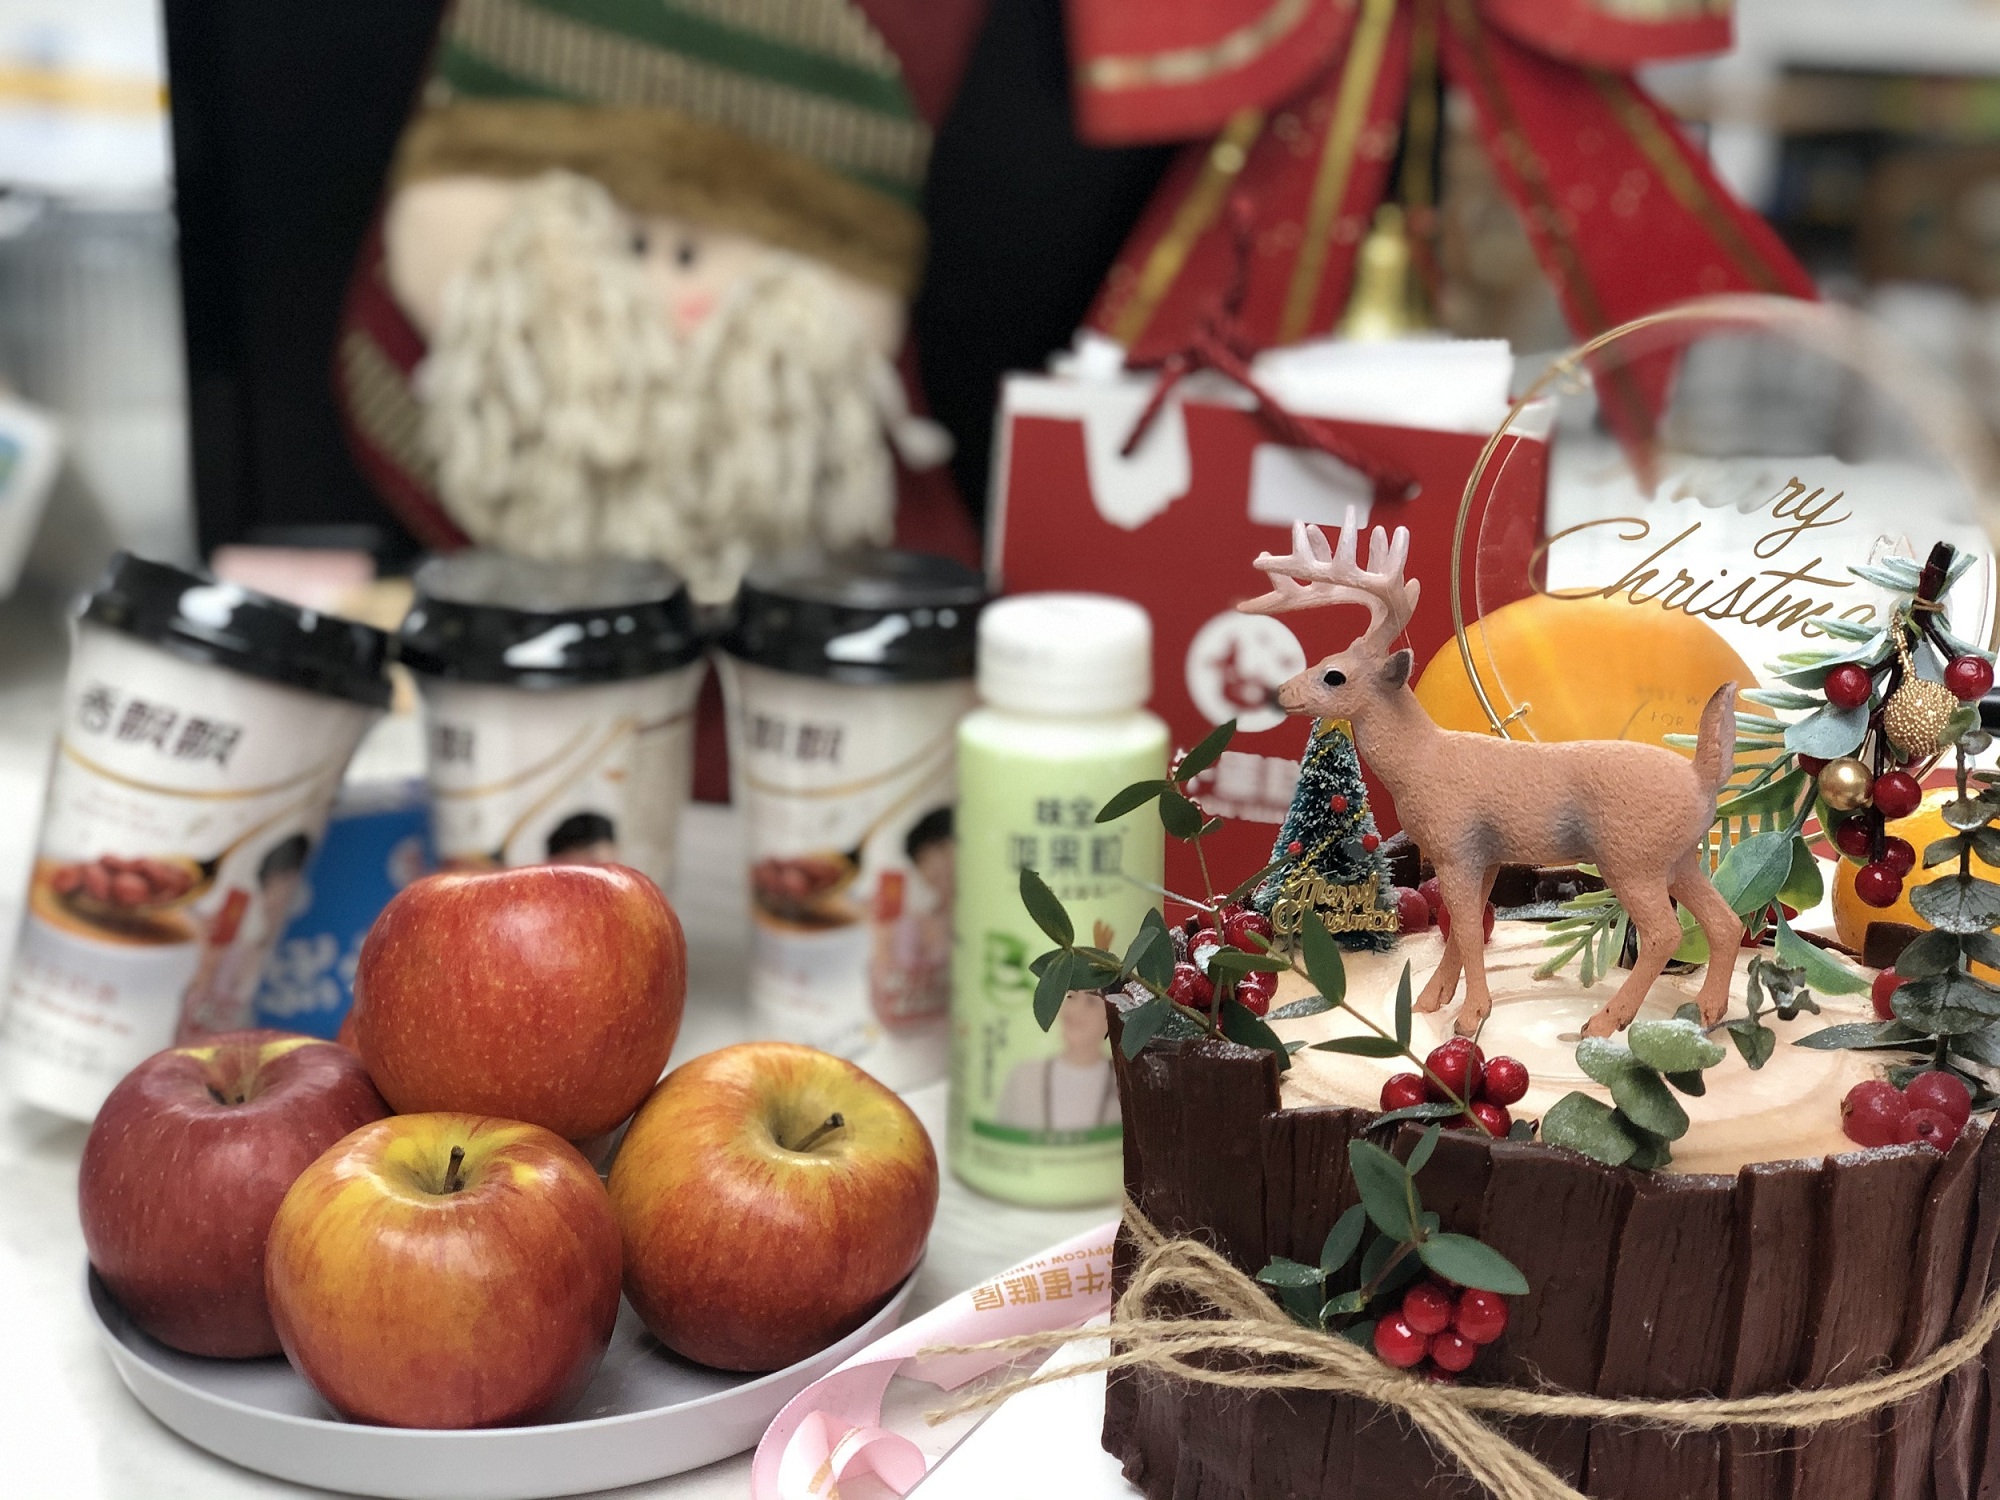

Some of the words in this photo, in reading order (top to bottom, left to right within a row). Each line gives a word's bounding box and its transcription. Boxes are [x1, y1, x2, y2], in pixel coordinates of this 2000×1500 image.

[1051, 1245, 1113, 1264] PPYCOW
[971, 1261, 1112, 1311] 牛蛋糕屋
